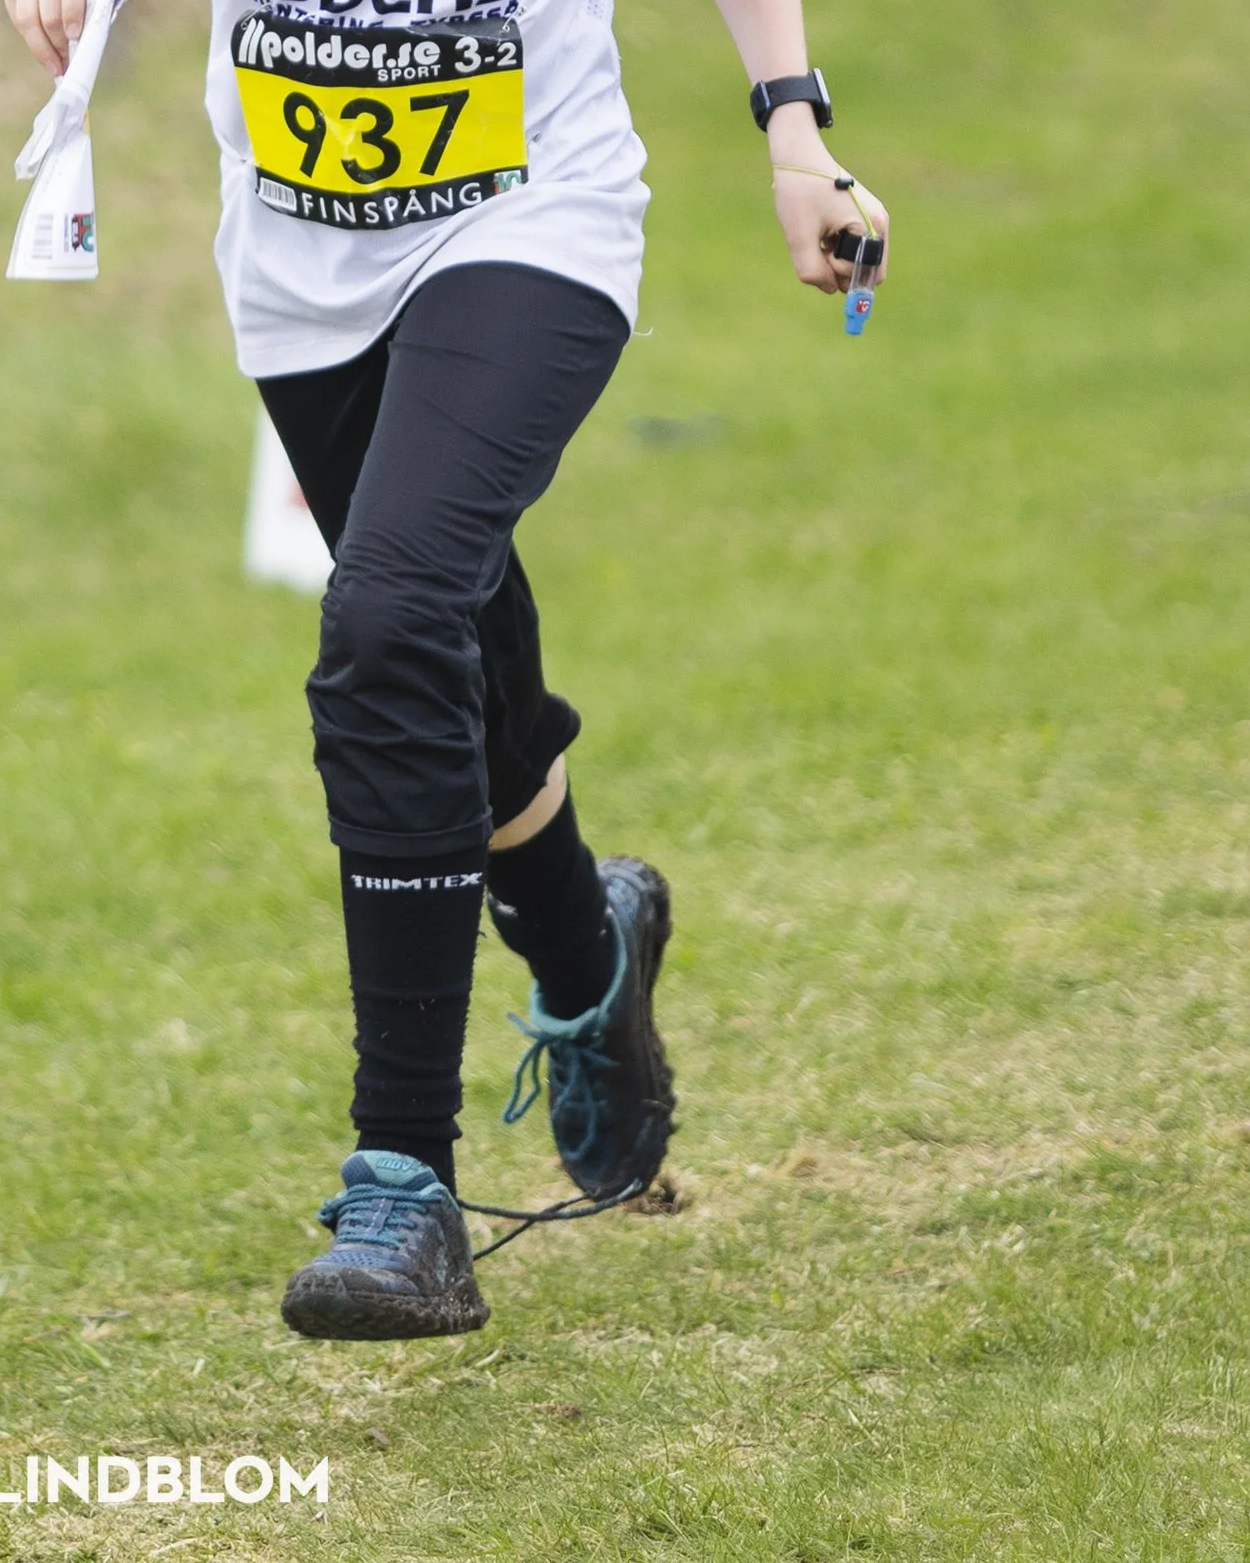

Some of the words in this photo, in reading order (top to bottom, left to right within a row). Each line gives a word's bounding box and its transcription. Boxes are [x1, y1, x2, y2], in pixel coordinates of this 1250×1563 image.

[377, 64, 441, 82] SPORT
[454, 36, 518, 73] 3-2
[283, 89, 470, 185] 937
[301, 181, 483, 224] FINSPÅNG
[351, 871, 484, 890] TRIMTEX
